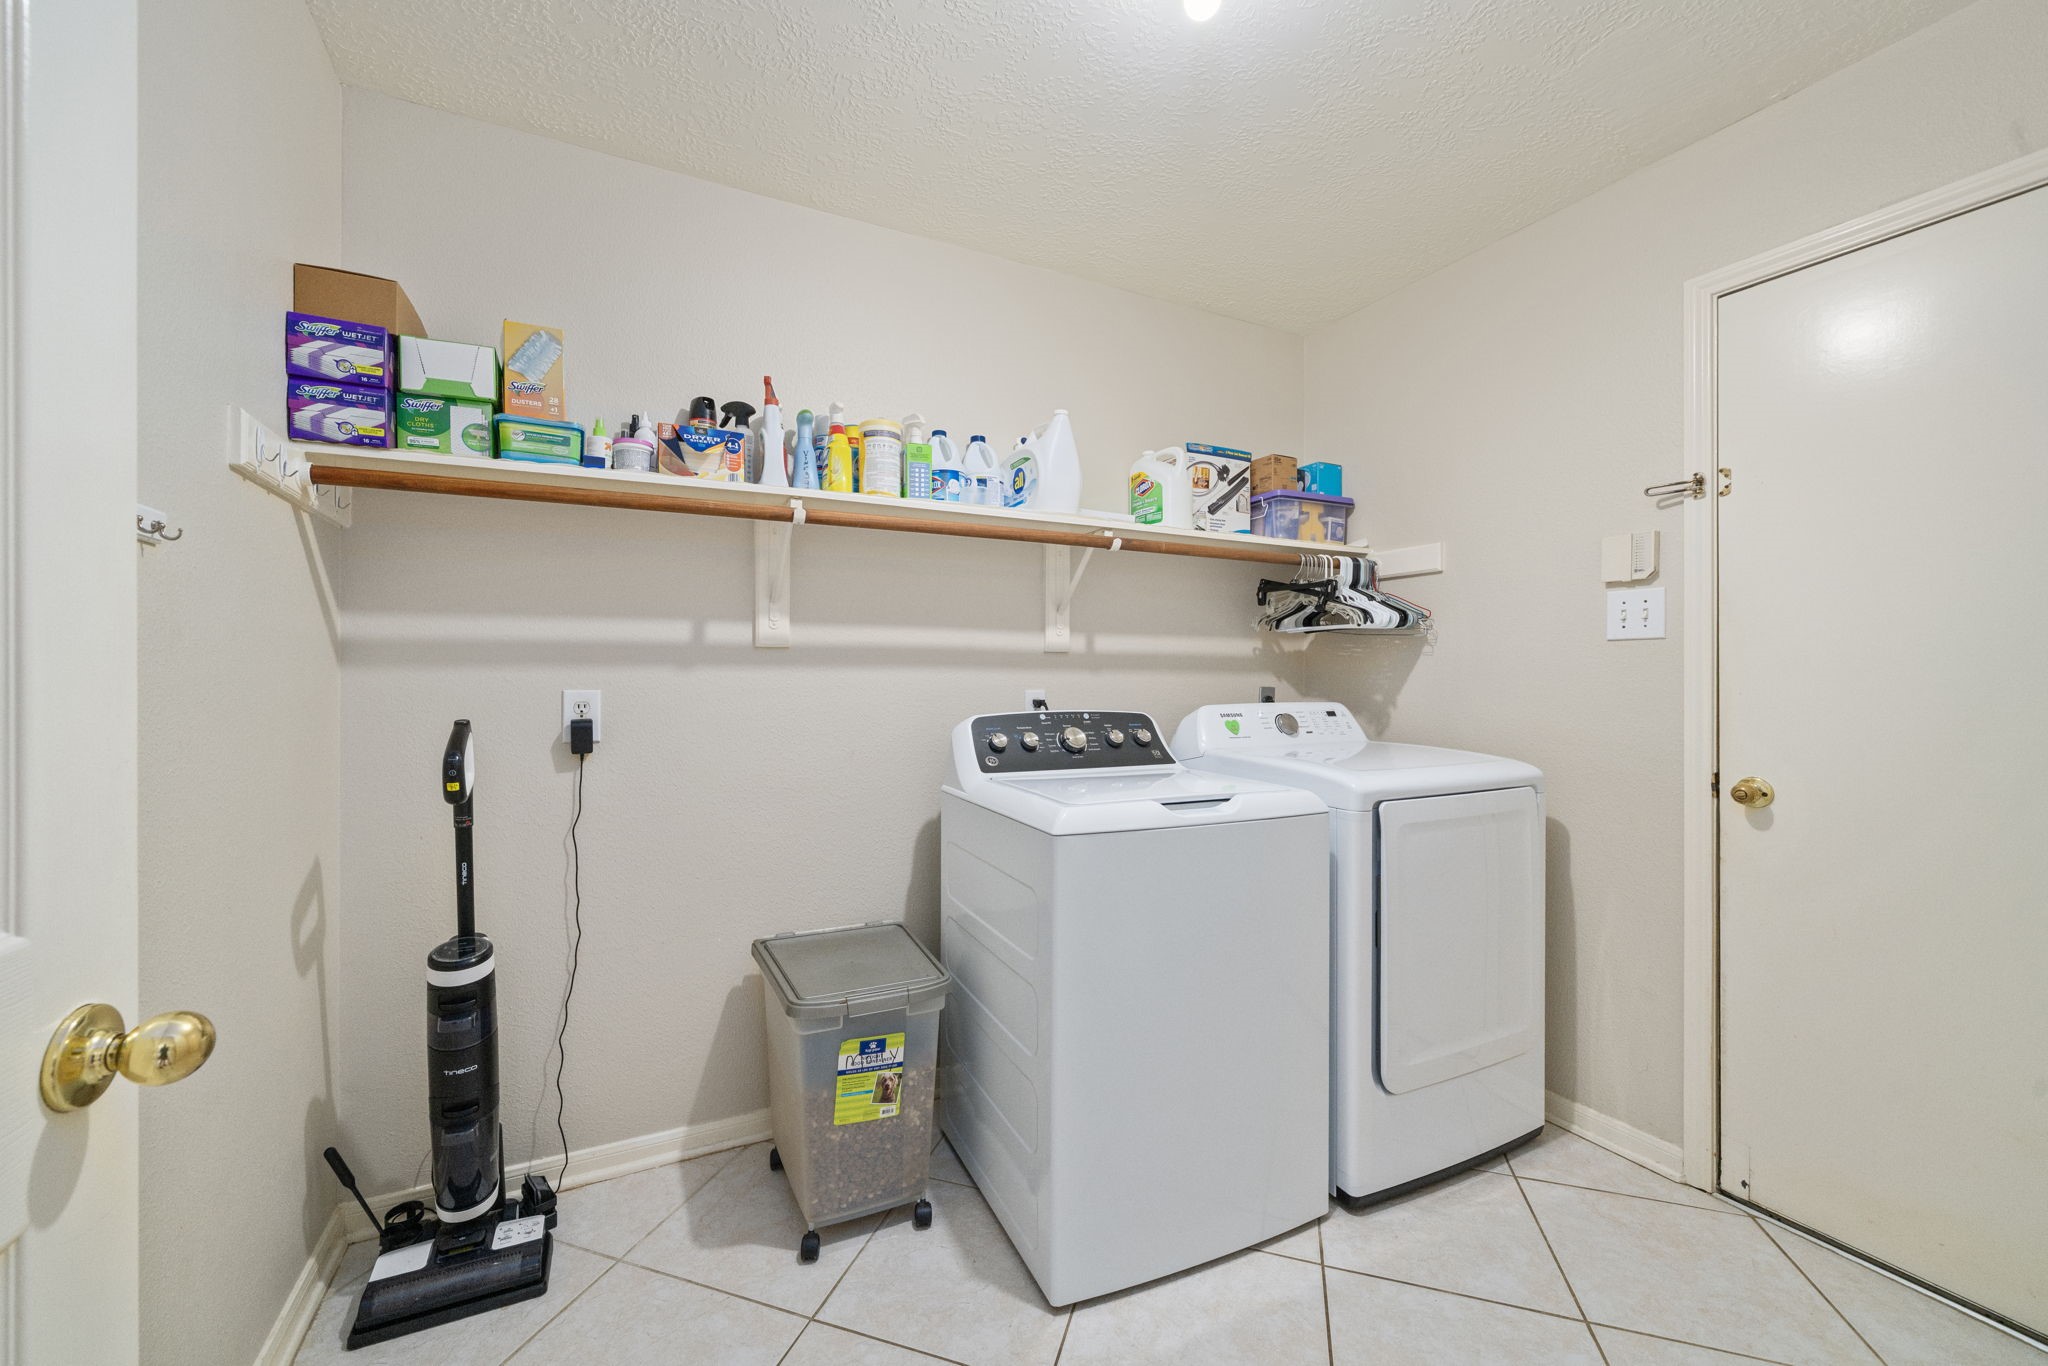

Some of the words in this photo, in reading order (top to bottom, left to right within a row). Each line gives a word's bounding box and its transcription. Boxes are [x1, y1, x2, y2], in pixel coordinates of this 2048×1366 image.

[295, 320, 340, 337] Swiffer
[342, 330, 379, 342] WETJET
[296, 384, 341, 399] Swiffer
[342, 393, 379, 403] WETJET
[508, 381, 544, 394] Swiffer
[401, 398, 443, 412] Swiffer
[511, 398, 542, 407] DUSTERS
[683, 433, 721, 442] DRYER
[1015, 471, 1024, 490] all
